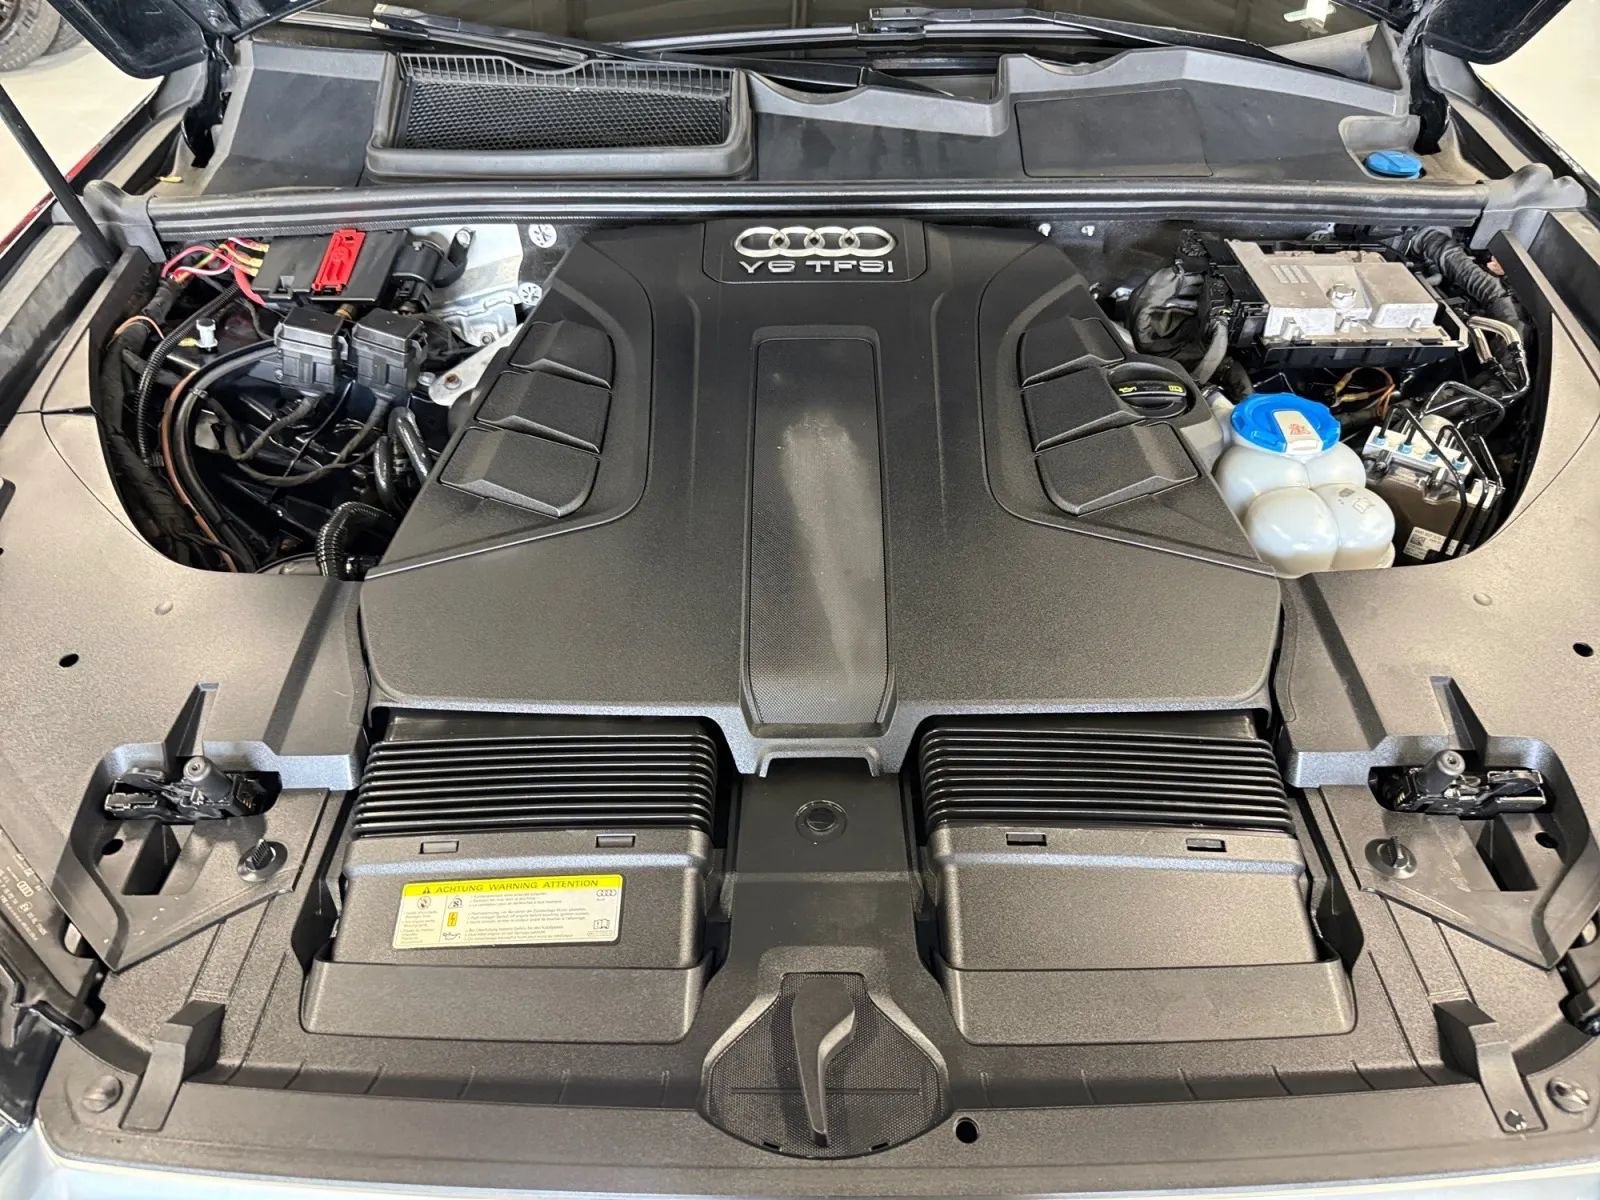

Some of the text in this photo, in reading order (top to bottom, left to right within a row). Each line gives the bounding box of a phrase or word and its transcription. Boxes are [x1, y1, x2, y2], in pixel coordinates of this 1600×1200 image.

[805, 260, 894, 273] TFSI
[435, 879, 599, 893] ACHTUNG WARNING ATTENTION
